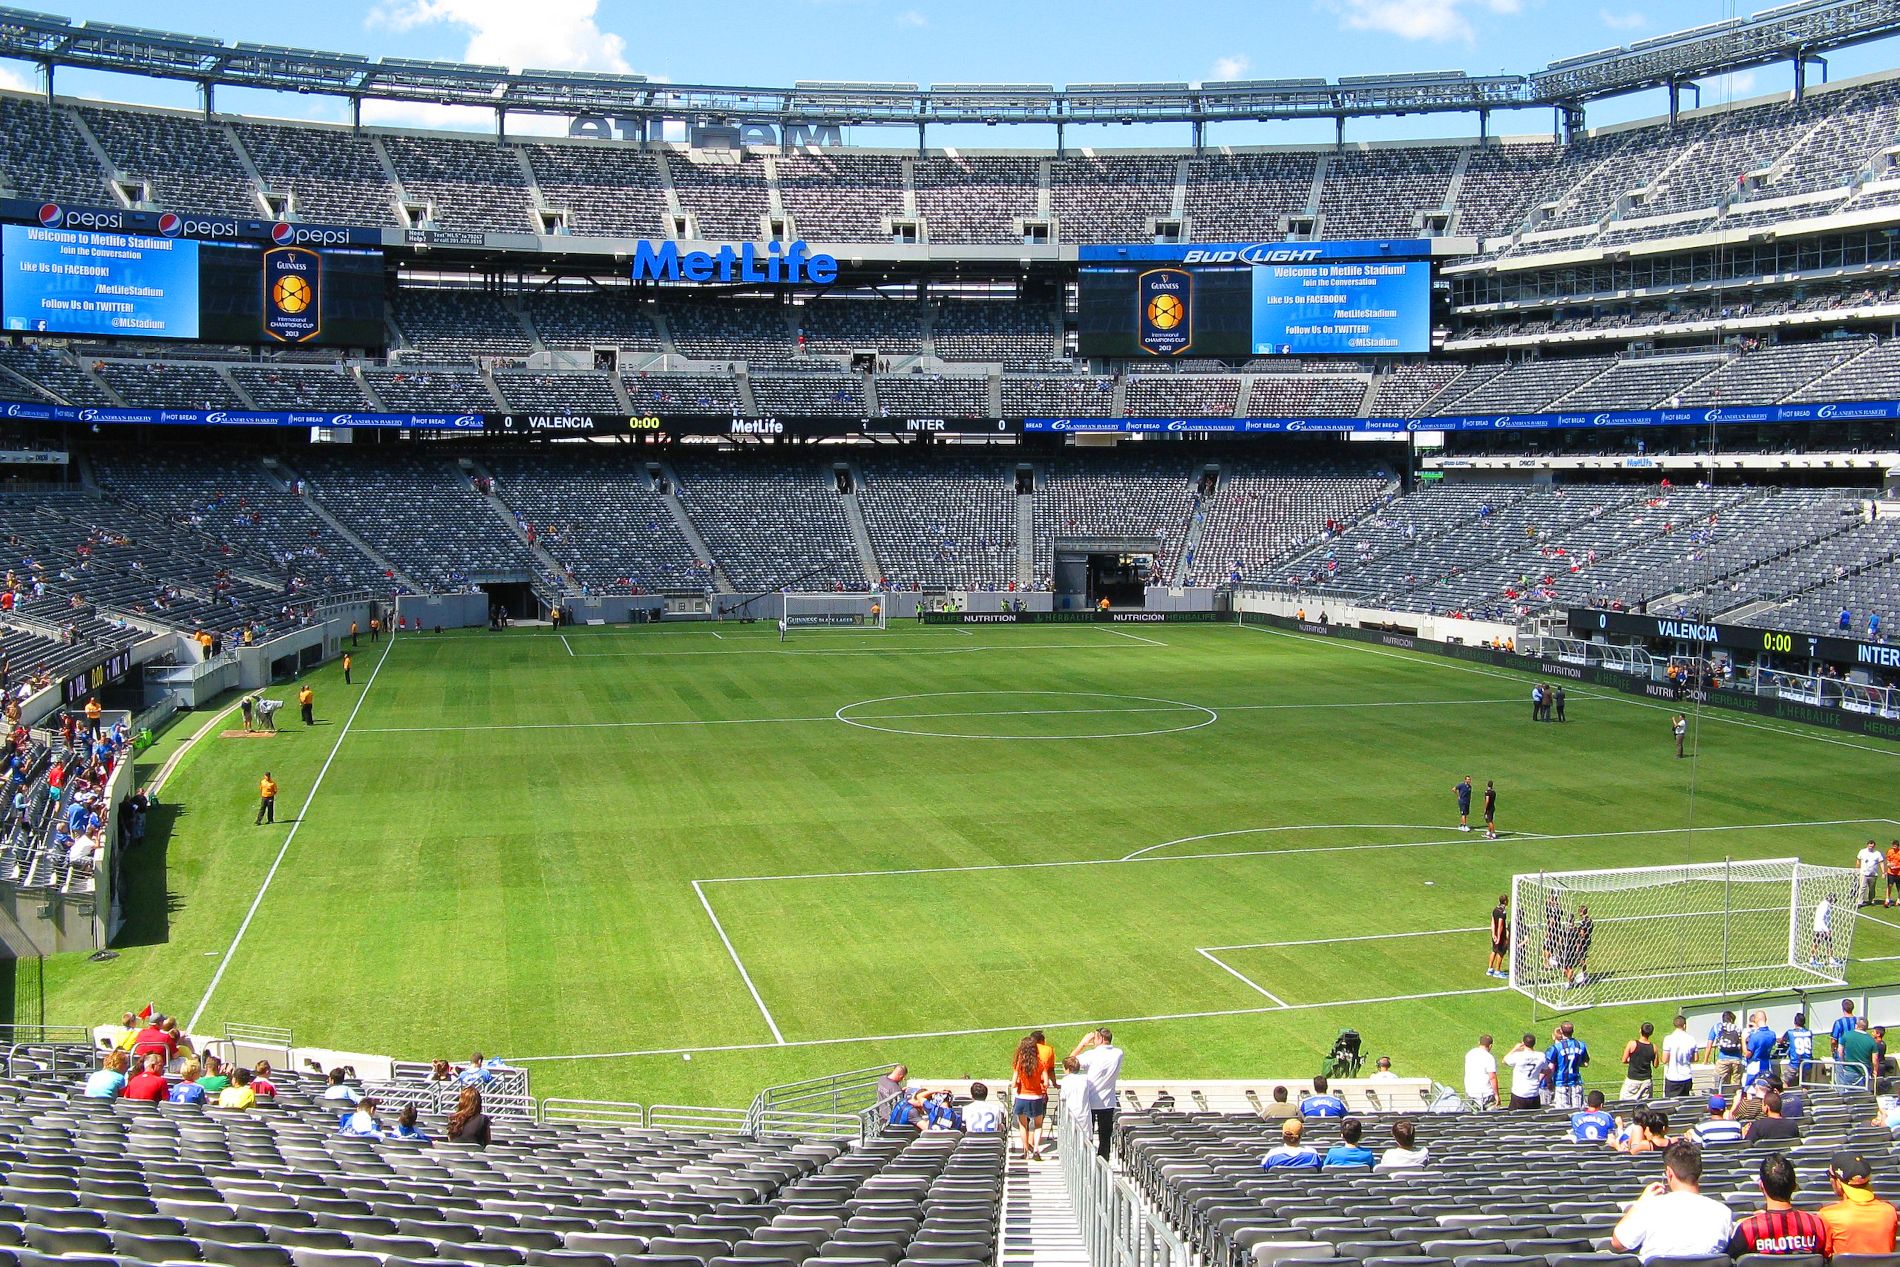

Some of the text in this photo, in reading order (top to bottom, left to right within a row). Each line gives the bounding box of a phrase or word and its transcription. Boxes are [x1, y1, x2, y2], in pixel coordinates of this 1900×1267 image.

[67, 212, 122, 230] pepsi
[184, 221, 238, 238] pepsi
[28, 229, 173, 251] Welcome to Metlife Stadium!
[297, 229, 350, 246] pepsi
[60, 246, 142, 260] Join the Conversation
[1183, 249, 1323, 263] BUD LIGHT
[277, 261, 307, 271] GUINNESS
[632, 239, 838, 284] MetLife
[21, 262, 110, 277] Like Us On FACEBOOK!
[1274, 265, 1406, 278] Welcome to Metlife Stadium!
[1303, 278, 1377, 287] Join the Conversation
[95, 284, 164, 297] /MetLifeStadium
[42, 299, 134, 313] Follow Us On TWITTER!
[1267, 295, 1347, 305] Like Us On FACEBOOK!
[1334, 310, 1397, 319] /MetLifeStadium
[112, 318, 165, 329] @MLStadium
[1286, 325, 1369, 335] Follow Us On TWITTER!
[1348, 338, 1398, 348] @MLStadium
[505, 417, 784, 434] 0 VALENCIA 0:00 MetLife
[907, 420, 945, 431] INTER
[998, 420, 1006, 431] 0
[787, 616, 818, 625] GUINNESS
[965, 615, 1016, 623] NUTRITION
[1045, 614, 1094, 622] HERBALIFE
[1114, 613, 1165, 622] NUTRICIÓN
[1298, 624, 1327, 635] NUTRITION
[1600, 614, 1791, 653] 0 VALENCIA 0:00
[1809, 644, 1900, 668] 1 INTER
[1542, 664, 1581, 679] NUTRITION
[1708, 692, 1758, 710] HERBALIFE
[1787, 707, 1840, 727] HERBALIFE
[1794, 1037, 1812, 1055] 99
[1526, 1063, 1536, 1078] 7
[1568, 1055, 1575, 1074] 7
[972, 1112, 996, 1132] 22
[1756, 1235, 1816, 1251] BALOTELLI
